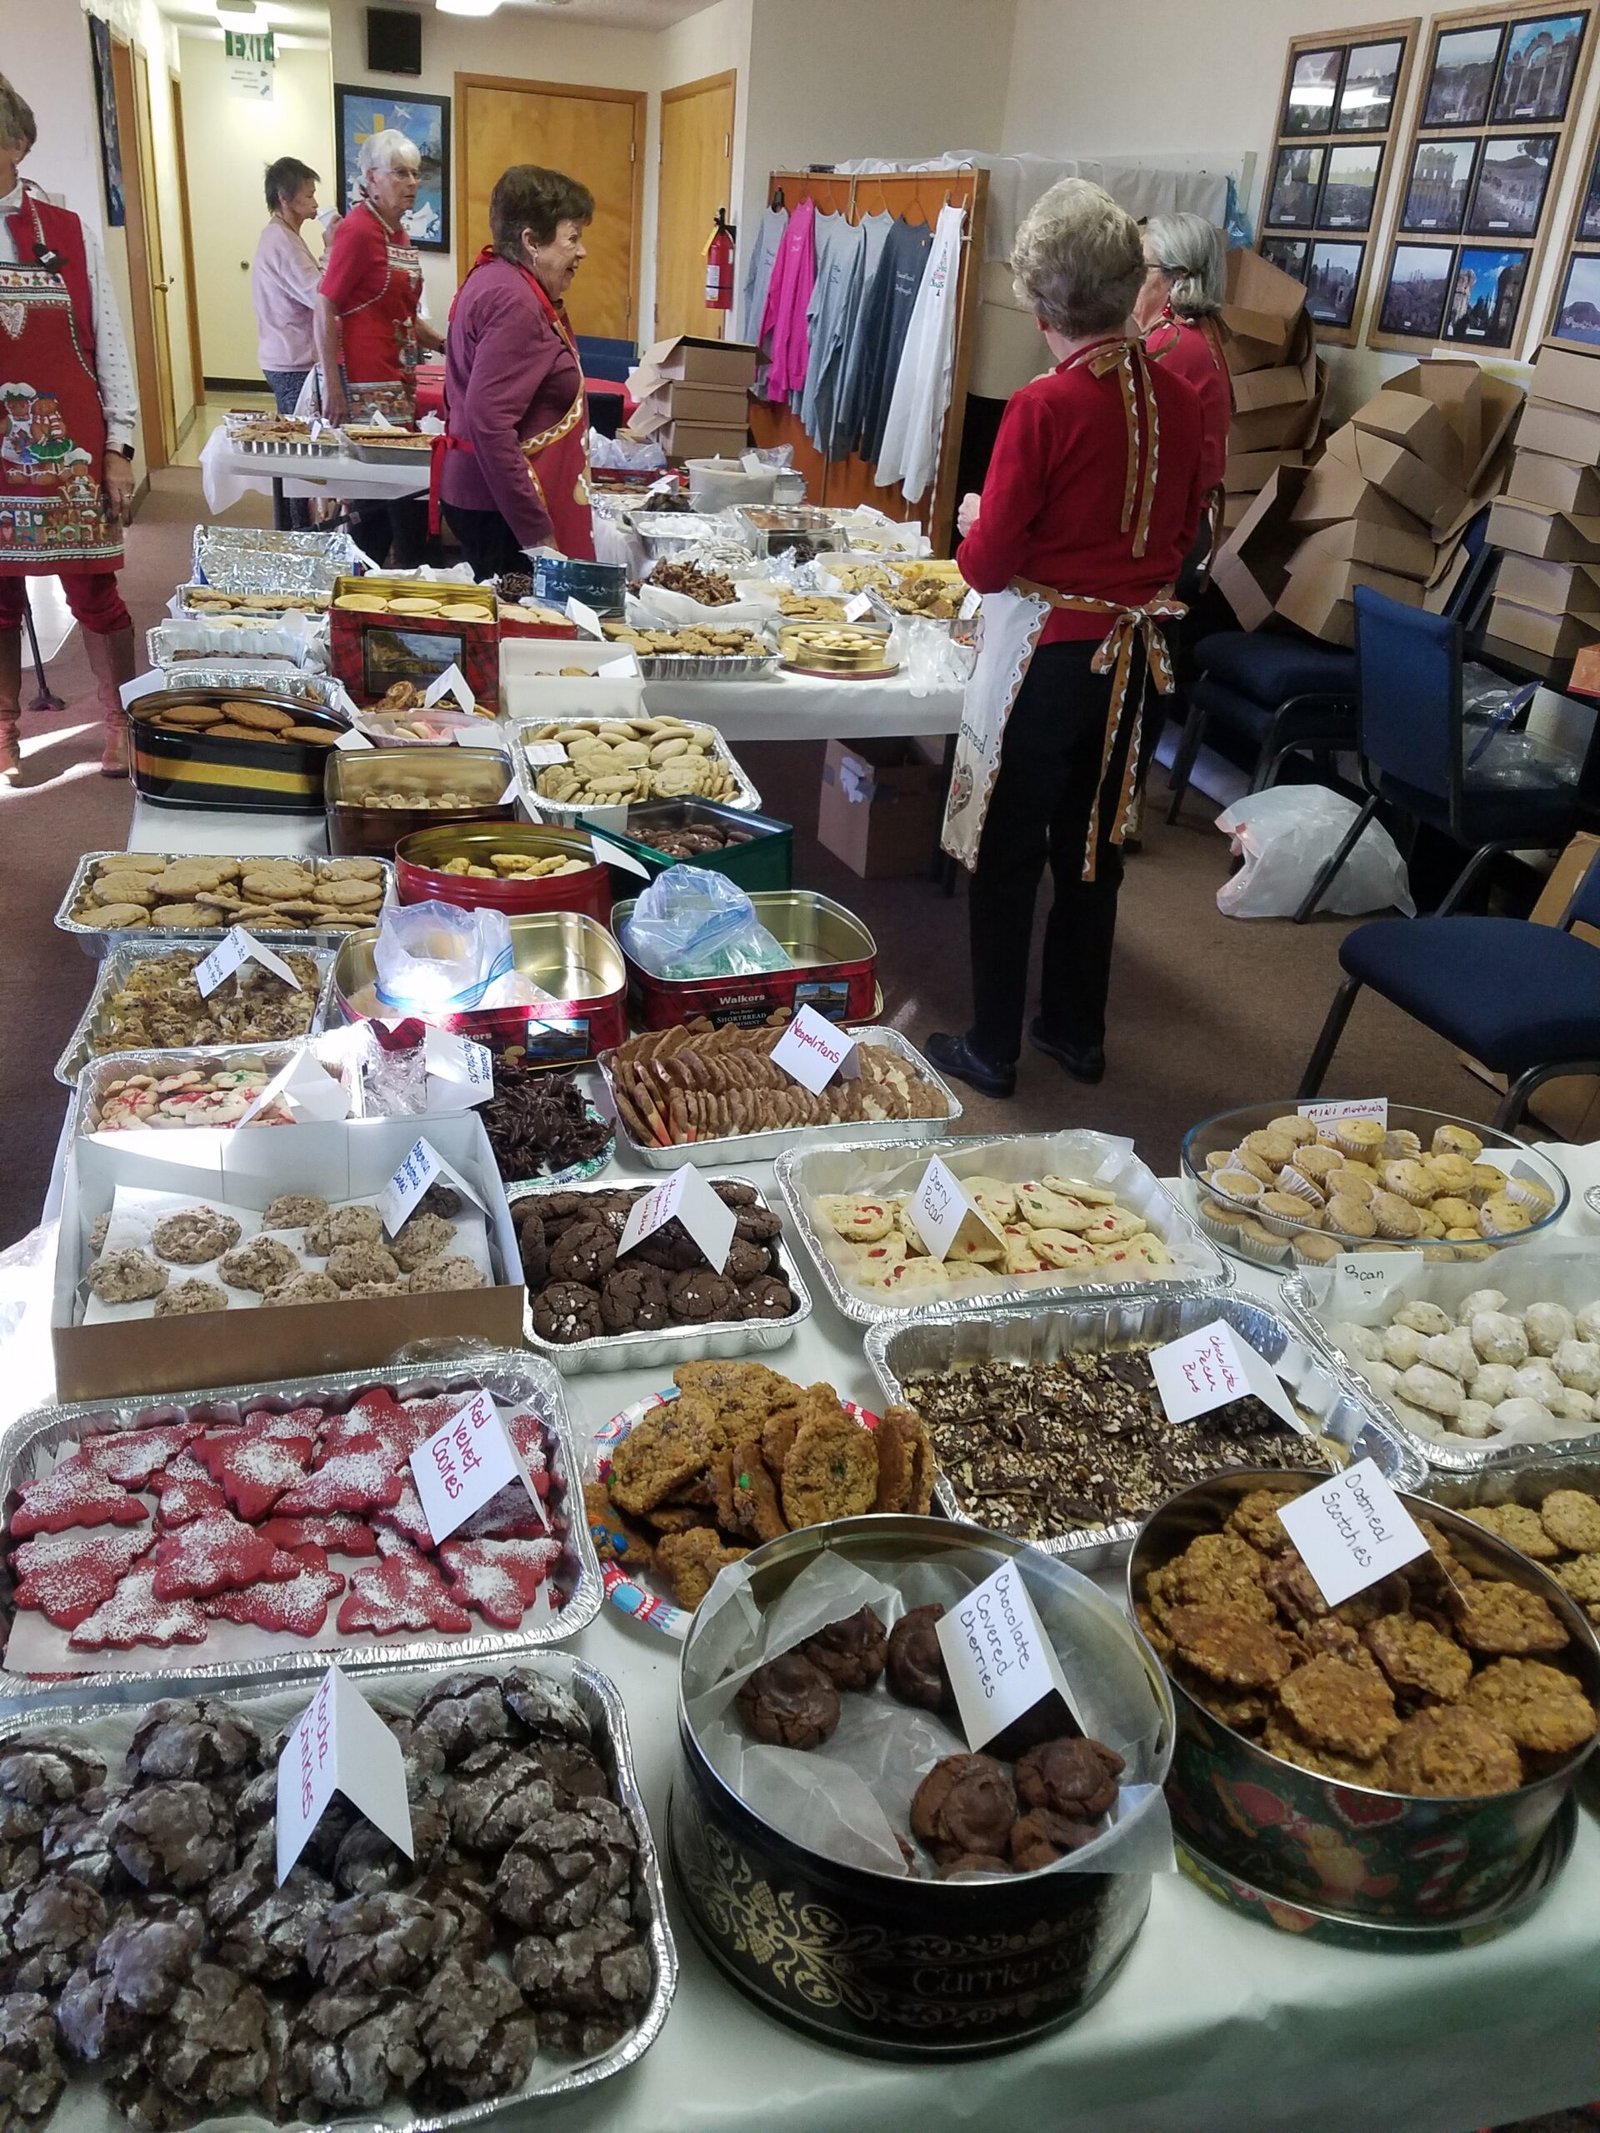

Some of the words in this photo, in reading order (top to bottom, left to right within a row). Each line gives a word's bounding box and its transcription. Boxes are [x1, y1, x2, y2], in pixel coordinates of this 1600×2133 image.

[231, 33, 266, 61] EXIT
[720, 995, 765, 1005] Walkers
[789, 1017, 840, 1064] Neopolitans
[921, 1185, 944, 1224] Pecan
[930, 1167, 952, 1211] Cherry
[468, 1397, 492, 1429] Red
[432, 1436, 464, 1499] Cookies
[452, 1418, 482, 1474] Velvet
[1321, 1491, 1373, 1568] Scotchies
[1344, 1473, 1394, 1544] Oatmeal
[976, 1594, 1015, 1676] Covered
[995, 1574, 1030, 1670] Chocolate
[316, 1675, 331, 1769] Mocha
